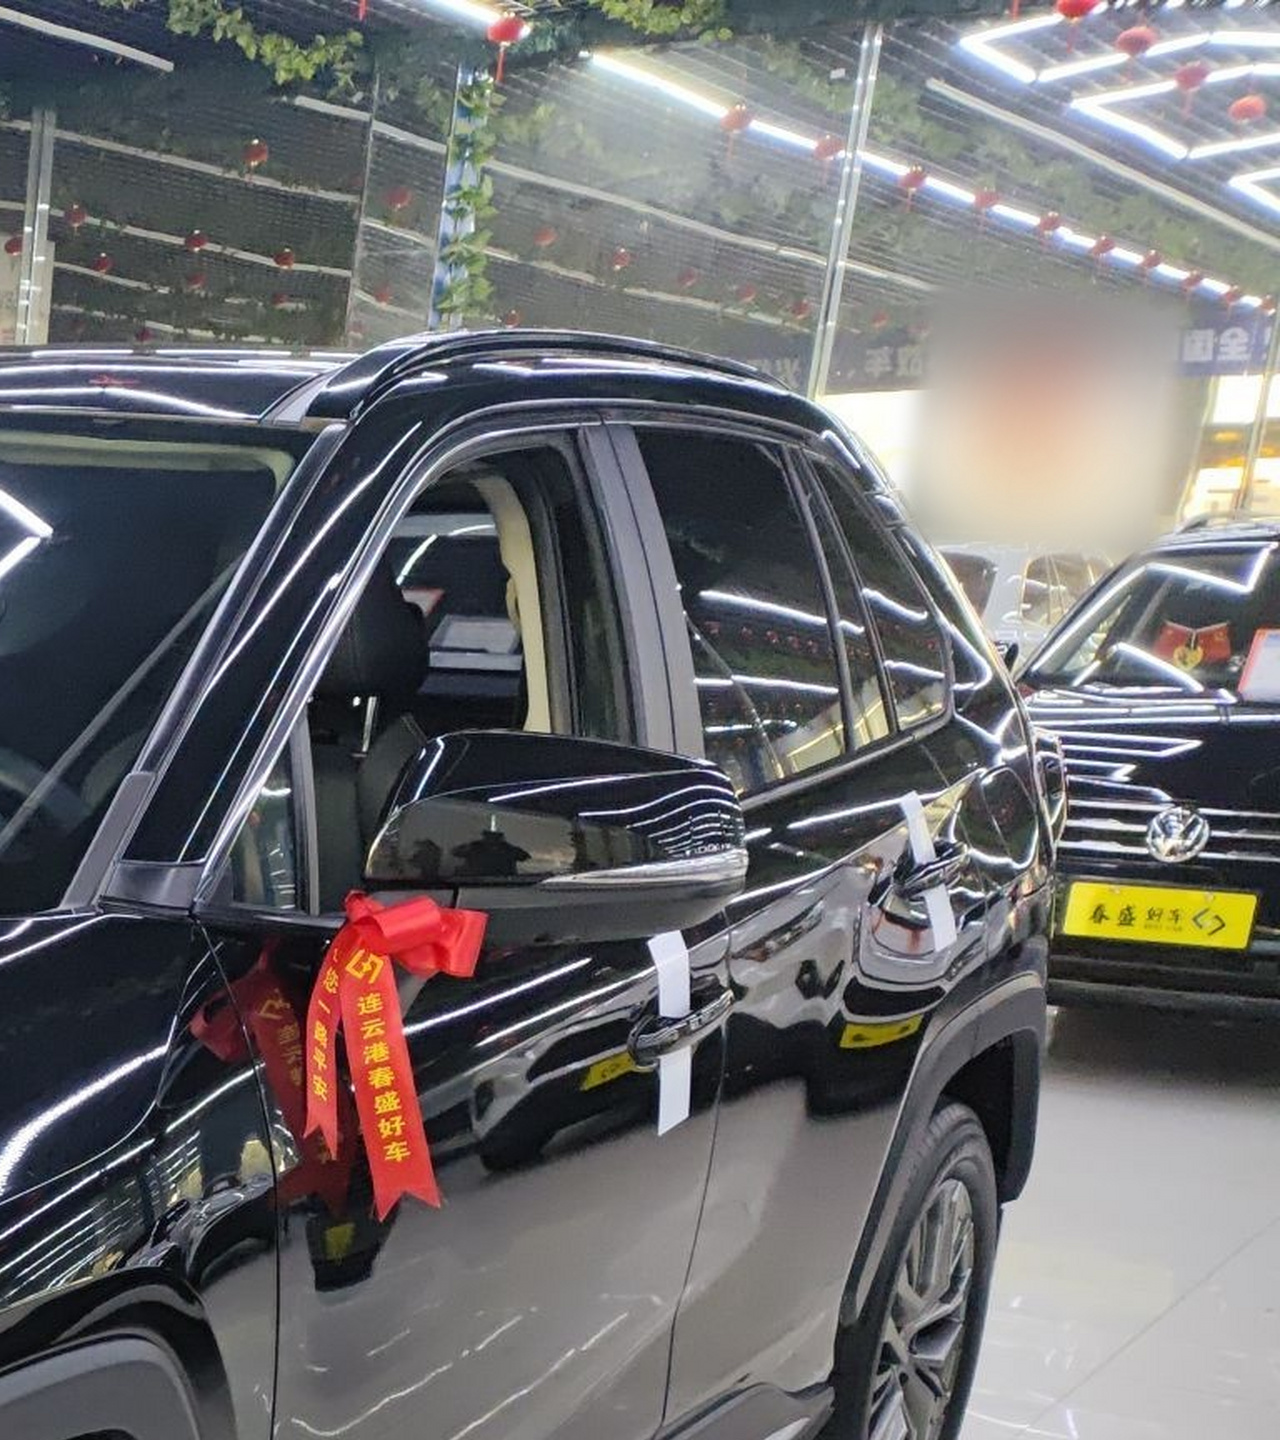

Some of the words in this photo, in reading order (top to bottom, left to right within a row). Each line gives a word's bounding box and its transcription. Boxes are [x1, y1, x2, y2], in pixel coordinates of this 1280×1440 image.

[357, 992, 411, 1162] 连云港春盛好车
